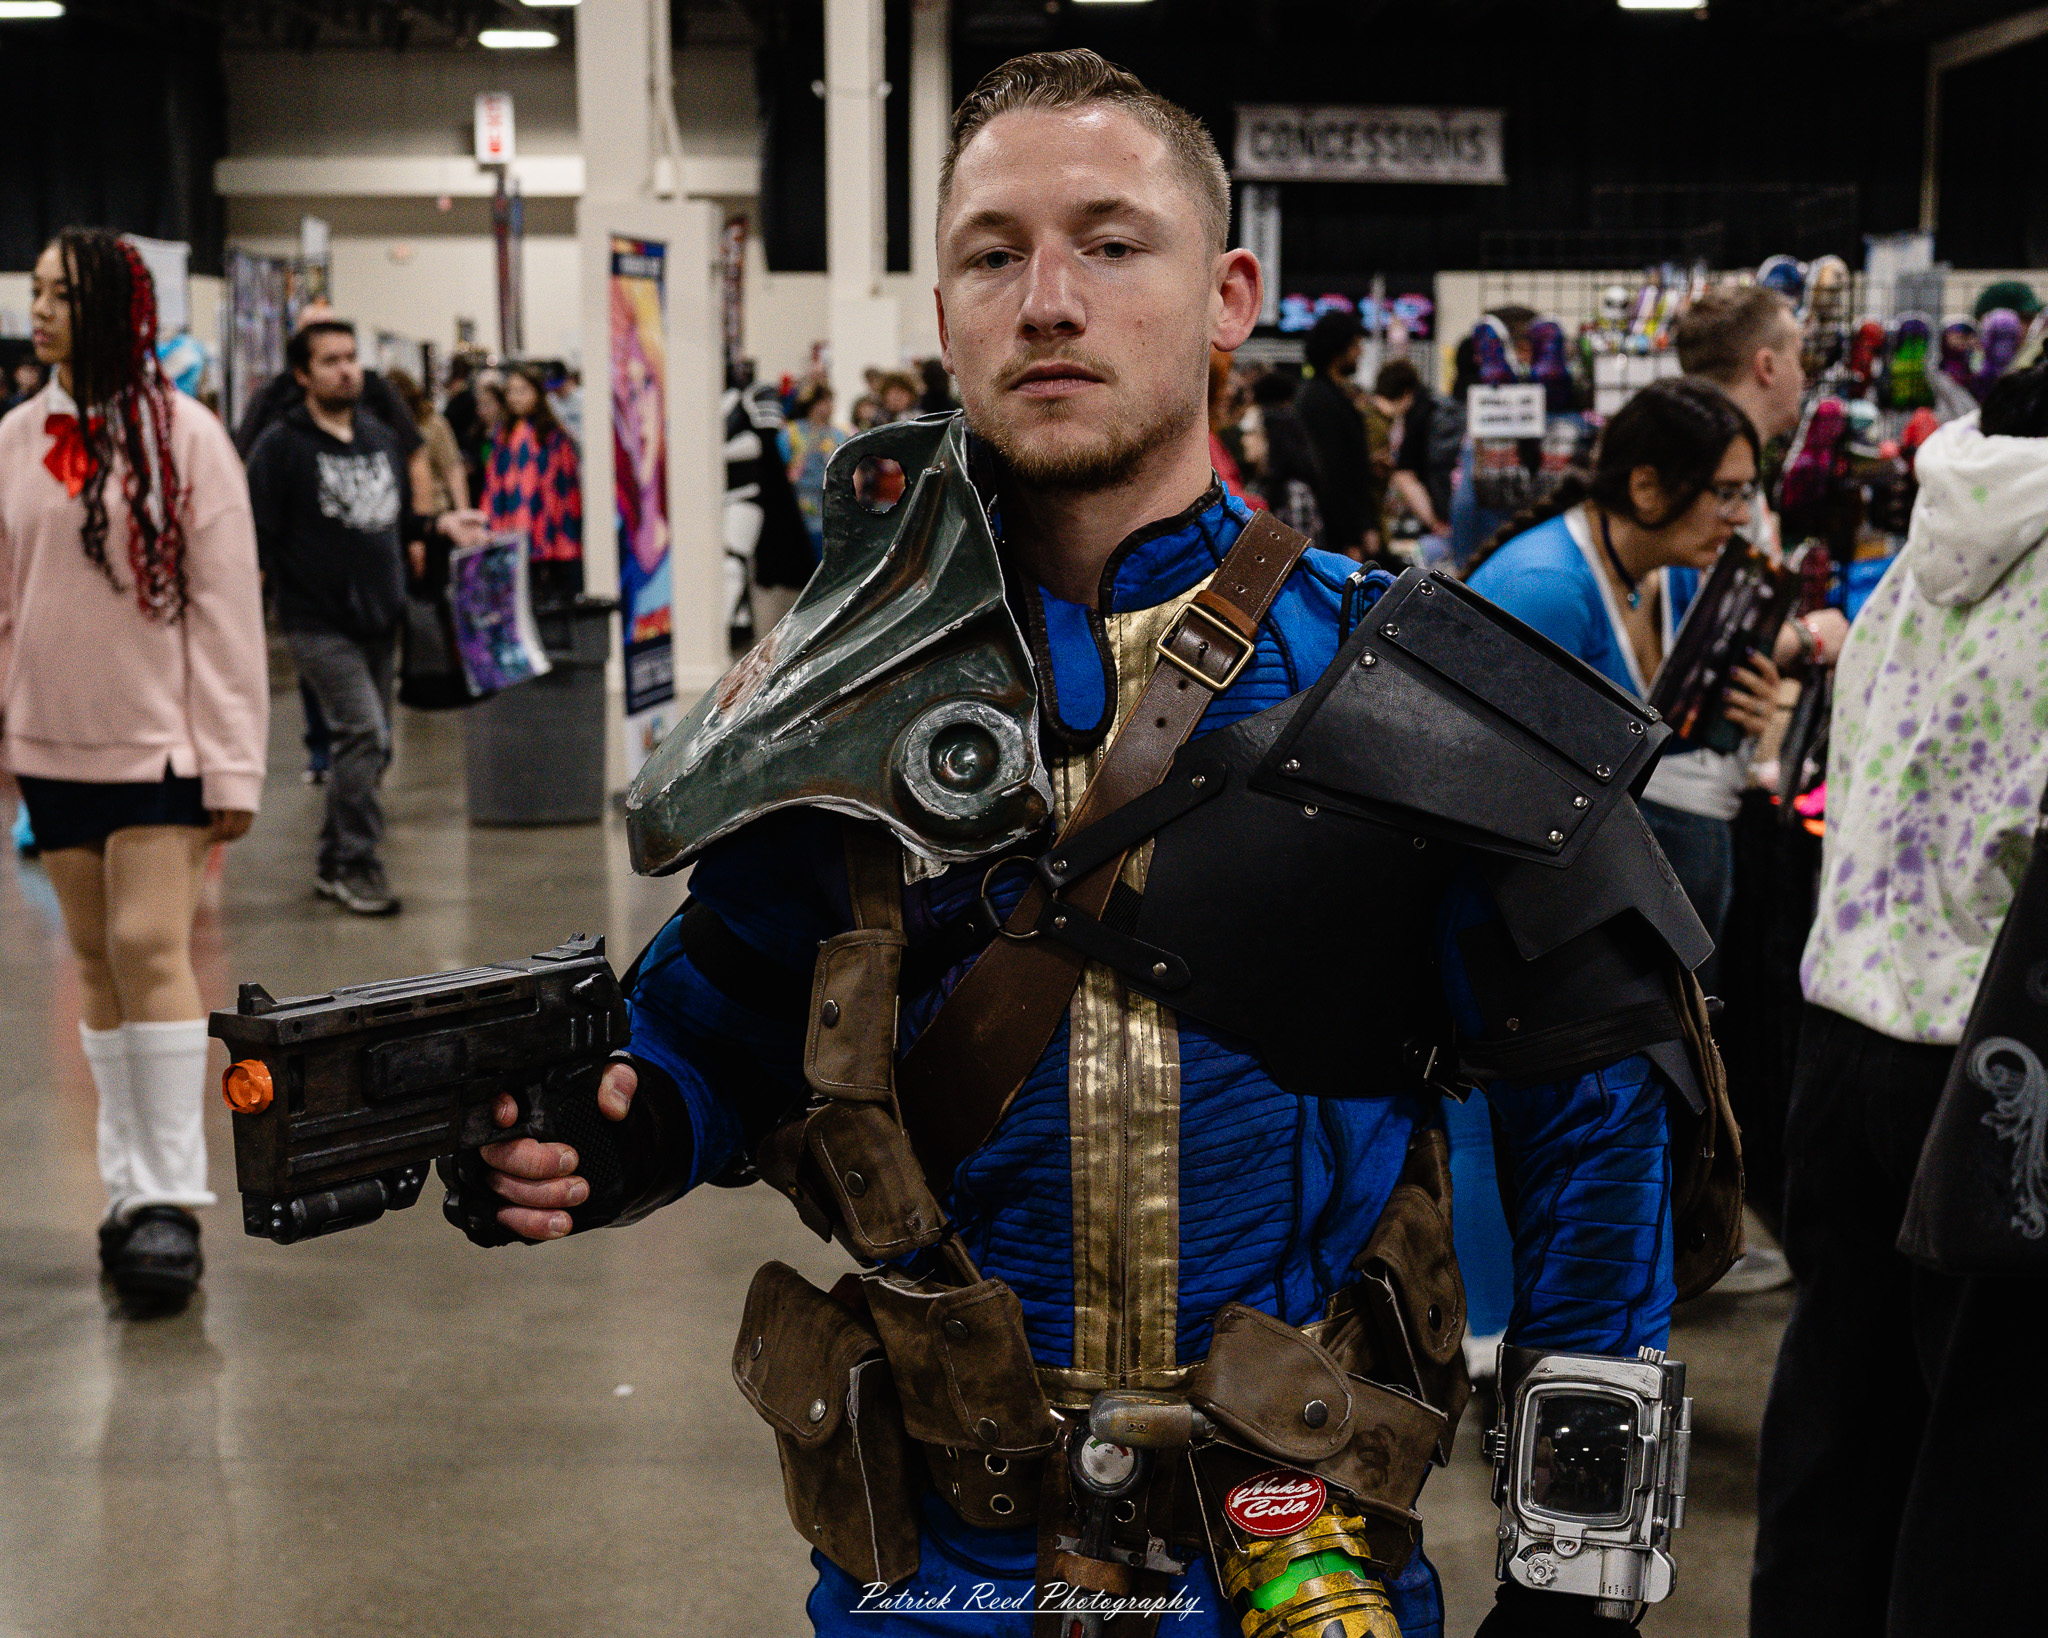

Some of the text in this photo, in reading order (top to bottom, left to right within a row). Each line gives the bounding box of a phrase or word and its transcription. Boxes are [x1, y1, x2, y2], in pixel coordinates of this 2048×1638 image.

[1251, 119, 1487, 164] CONCESSIONS
[1230, 1476, 1314, 1508] Nuka
[1243, 1498, 1310, 1518] Cola
